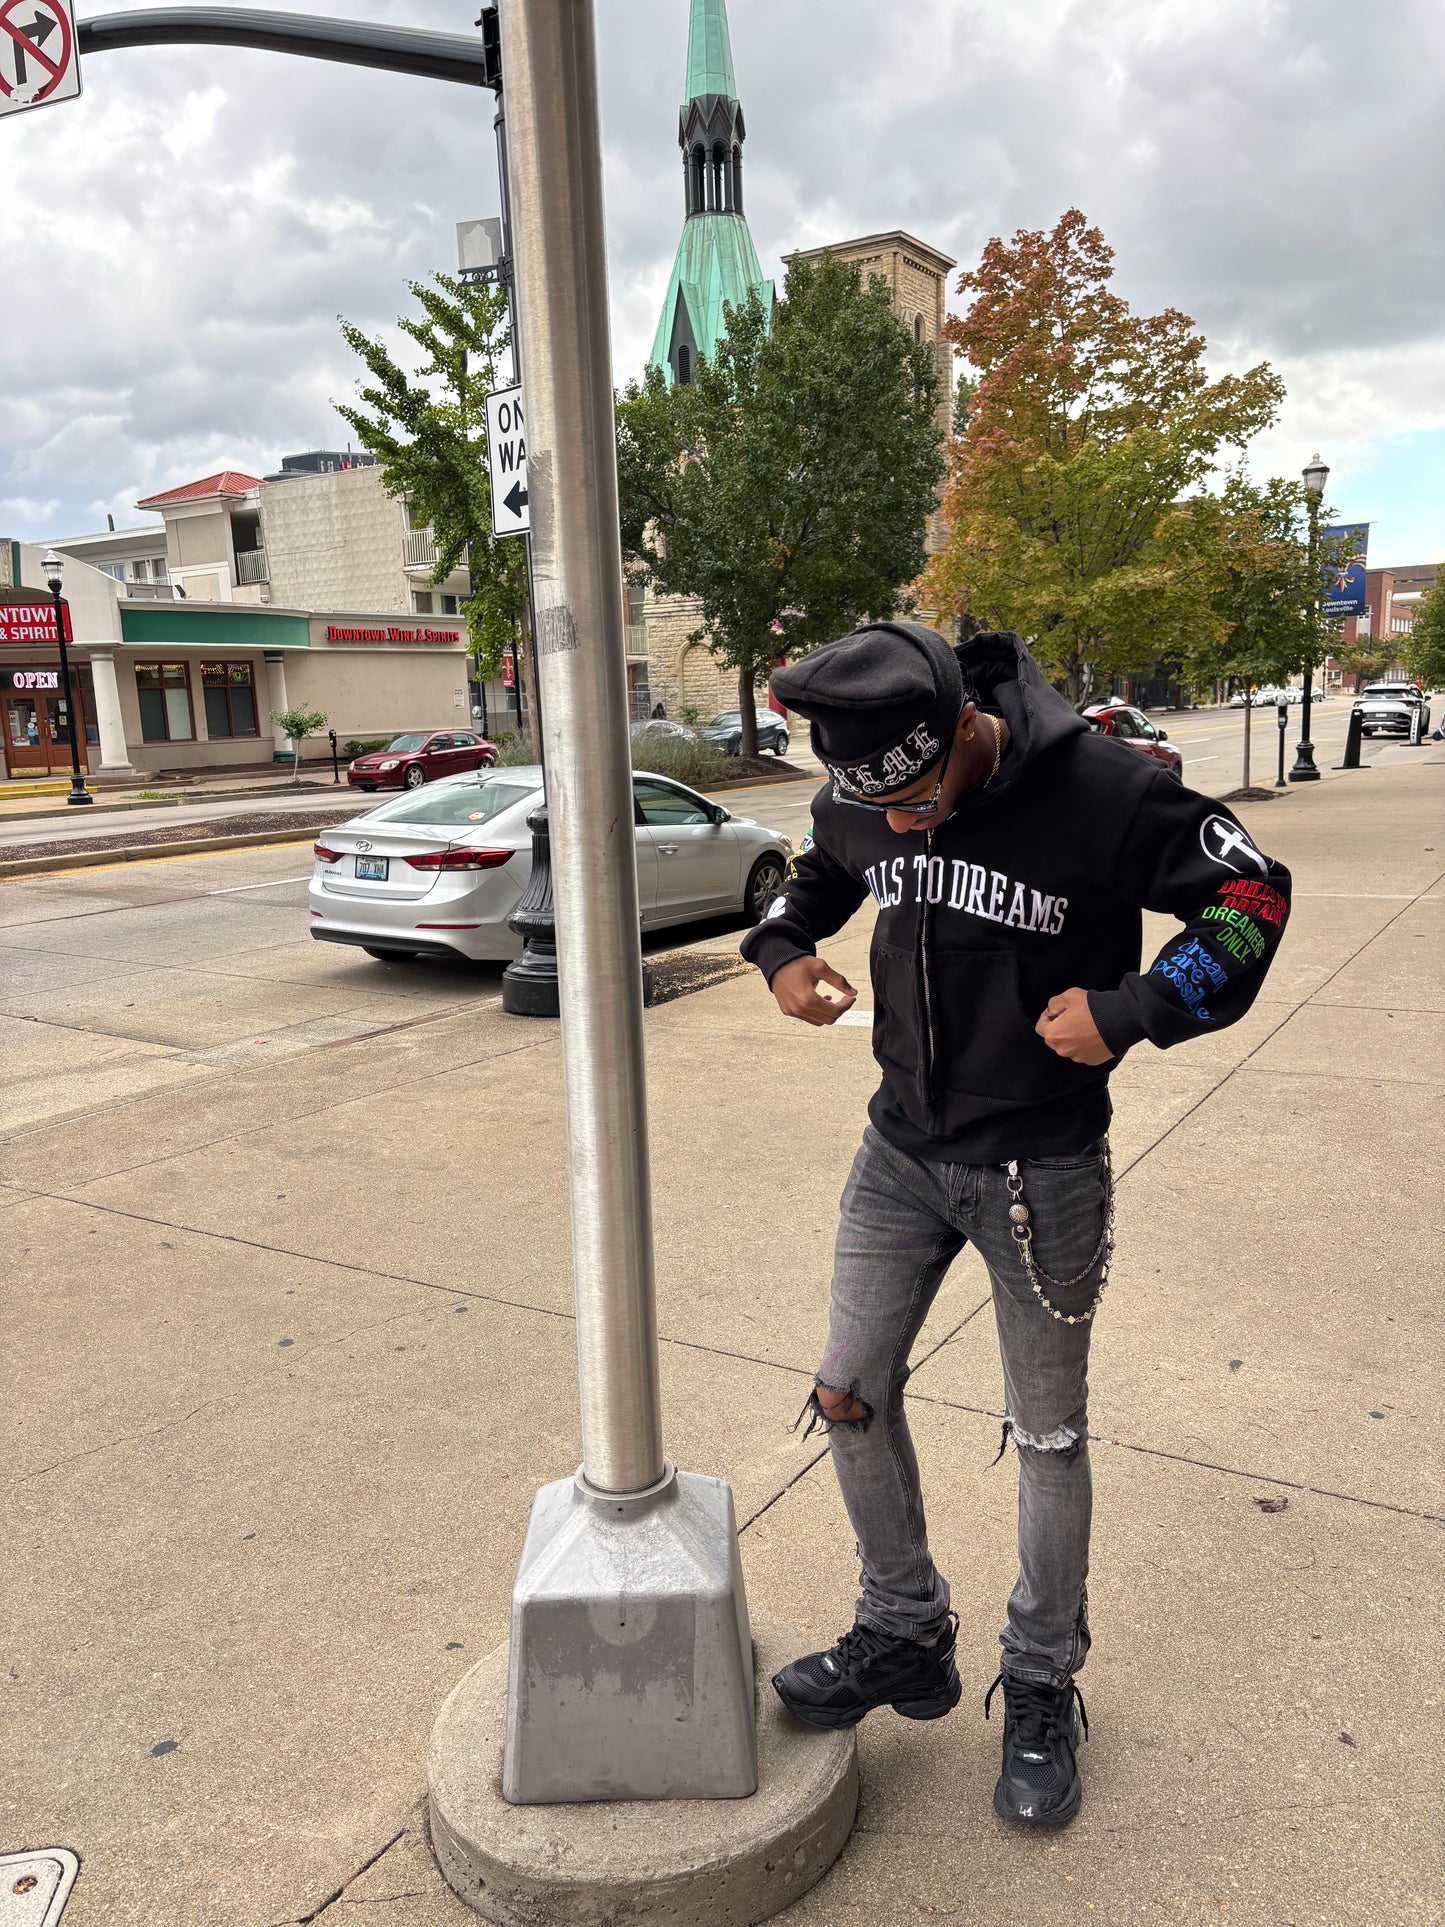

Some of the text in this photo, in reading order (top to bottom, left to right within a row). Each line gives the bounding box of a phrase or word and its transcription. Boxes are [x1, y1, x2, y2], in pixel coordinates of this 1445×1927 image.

[10, 626, 58, 640] SPIRIT
[327, 626, 460, 642] DOWNTOWN WINE & SPIRITS
[13, 671, 58, 688] OPEN
[913, 855, 944, 904] TO
[947, 859, 1069, 935] DREAMS
[1202, 906, 1265, 959] DREAMERS
[1171, 953, 1204, 984] are
